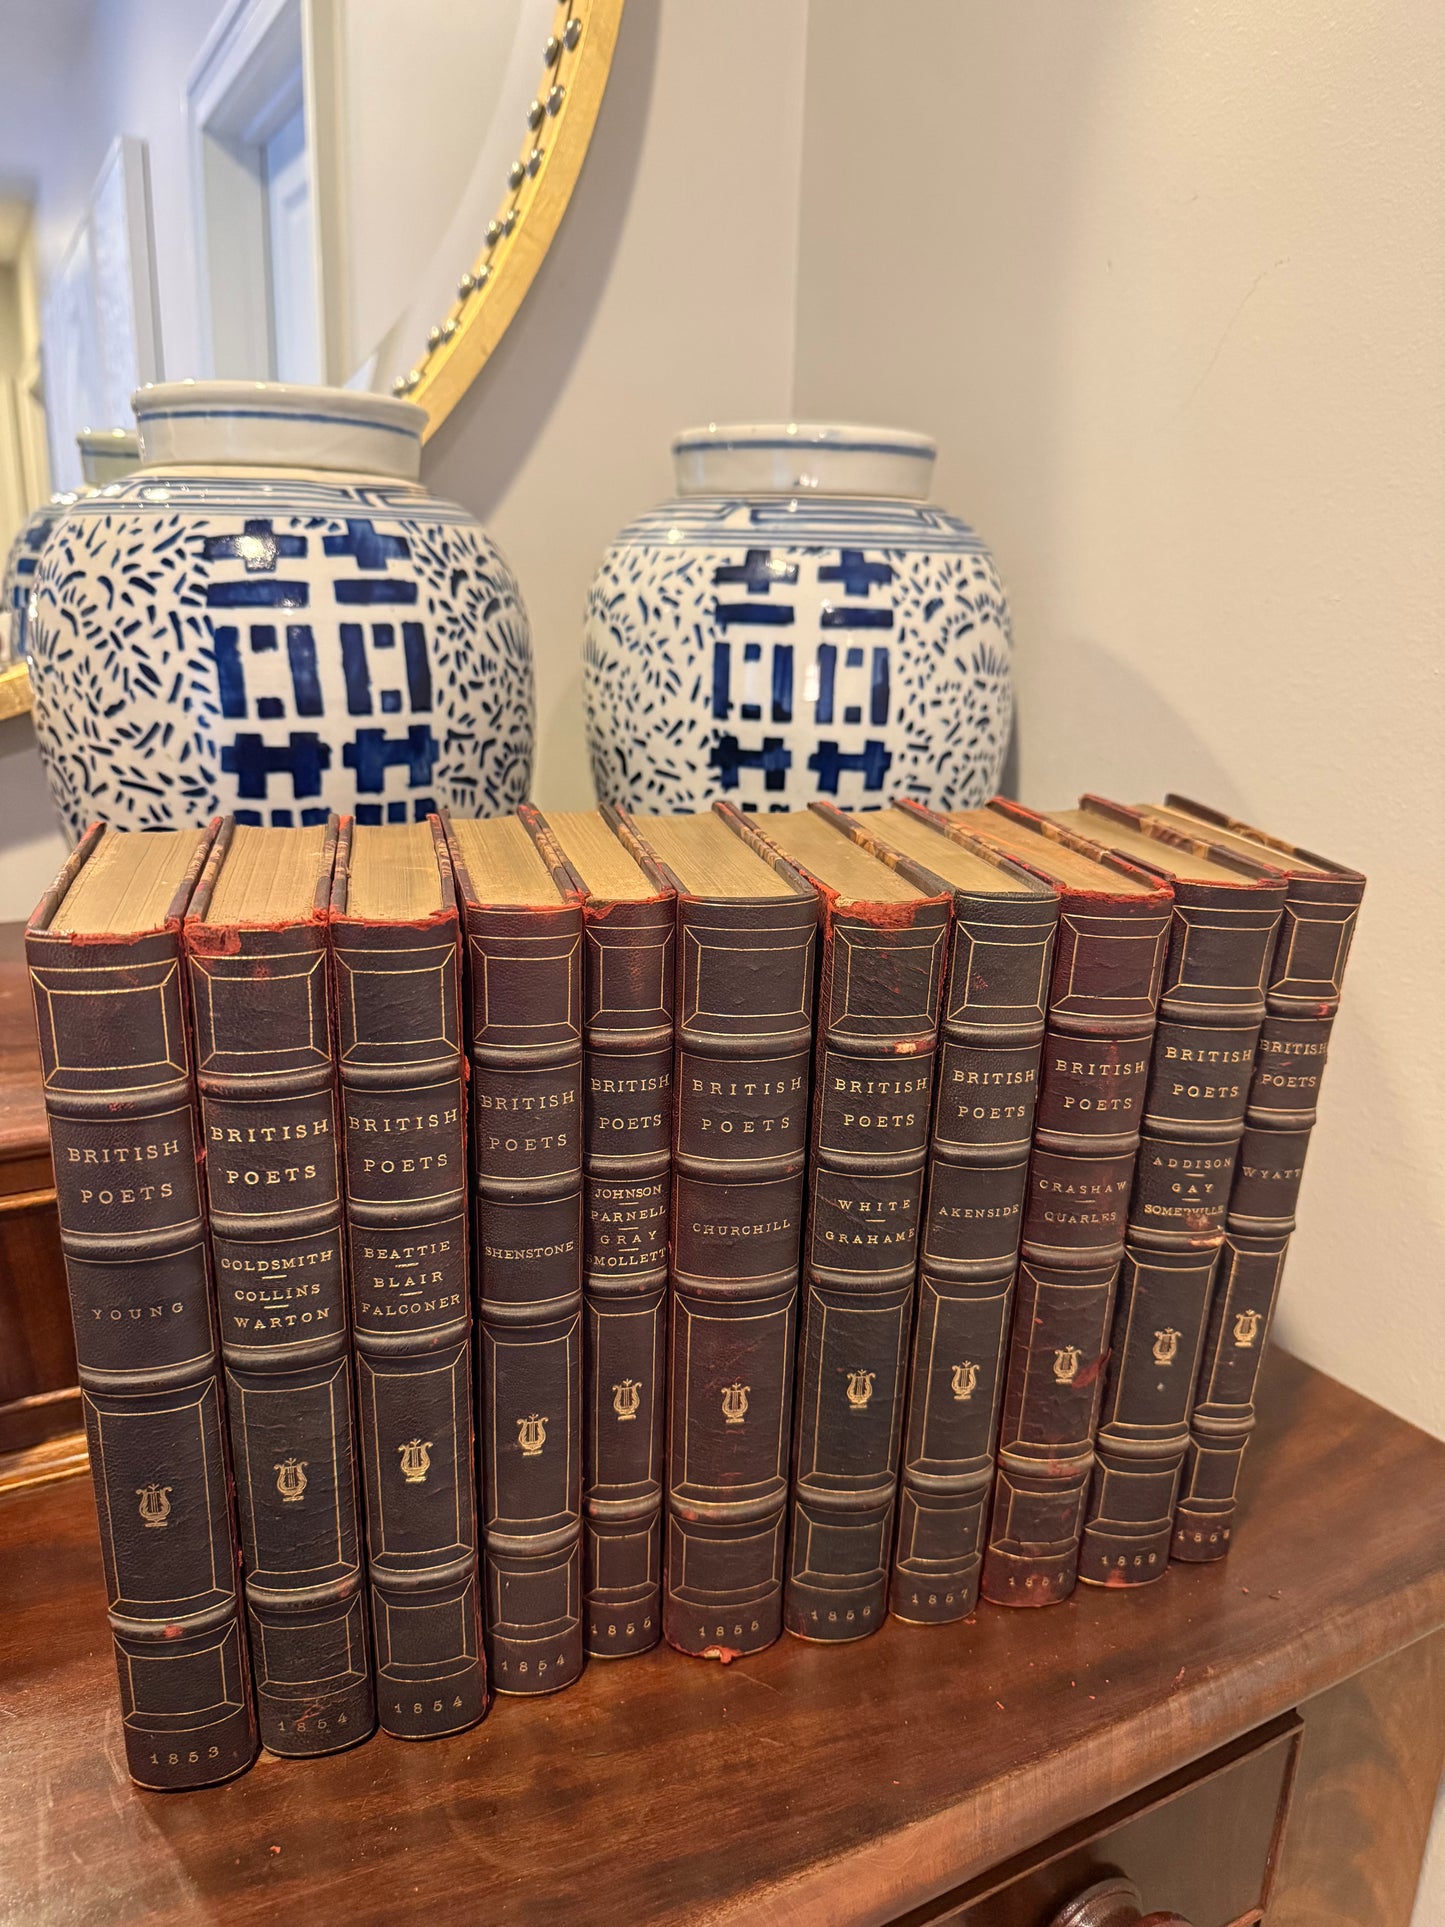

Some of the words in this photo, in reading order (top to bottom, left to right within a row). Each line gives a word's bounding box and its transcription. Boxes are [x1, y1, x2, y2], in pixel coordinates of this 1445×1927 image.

[1165, 1046, 1252, 1063] BRITISH
[1261, 1040, 1327, 1055] BRITISH
[952, 1069, 1035, 1085] BRITISH
[1055, 1060, 1145, 1077] BRITISH
[591, 1074, 670, 1093] BRITISH
[692, 1076, 802, 1096] BRITISH
[835, 1077, 928, 1095] BRITISH
[1262, 1074, 1317, 1087] POETS
[1172, 1083, 1240, 1098] POETS
[481, 1090, 575, 1111] BRITISH
[1064, 1096, 1132, 1111] POETS
[348, 1109, 458, 1132] BRITISH
[844, 1113, 915, 1128] POETS
[958, 1105, 1025, 1120] POETS
[210, 1118, 329, 1142] BRITISH
[599, 1114, 662, 1130] POETS
[701, 1117, 790, 1134] POETS
[489, 1134, 568, 1151] POETS
[68, 1140, 180, 1163] BRITISH
[364, 1154, 448, 1173] POETS
[1153, 1156, 1232, 1169] ADDISON
[227, 1165, 316, 1185] POETS
[1242, 1166, 1301, 1179] WYATT
[81, 1183, 173, 1204] POETS
[595, 1184, 662, 1199] JOHNSON
[1039, 1180, 1127, 1194] CRASHAW
[1171, 1183, 1214, 1194] GAY
[591, 1205, 666, 1222] PARNELL
[838, 1199, 911, 1212] WHITE
[938, 1204, 1019, 1218] AKENSIDE
[1044, 1211, 1117, 1224] QUARLES
[693, 1219, 791, 1237] CHURCHILL
[825, 1228, 915, 1244] GRAHAME
[600, 1230, 657, 1245] GRAY
[364, 1241, 451, 1260] BEATTIE
[485, 1241, 574, 1260] SHENSTONE
[586, 1247, 666, 1267] SMOLLETT
[221, 1250, 333, 1272] GOLDSMITH
[373, 1271, 443, 1288] BLAIR
[234, 1283, 321, 1302] COLLINS
[91, 1301, 184, 1320] YOUNG
[362, 1294, 461, 1316] FALCONER
[233, 1307, 330, 1330] WARTON
[912, 1589, 968, 1604] 1857
[502, 1654, 565, 1672] 1854
[394, 1696, 463, 1715] 1854
[278, 1712, 347, 1732] 1854
[150, 1746, 219, 1765] 1853
